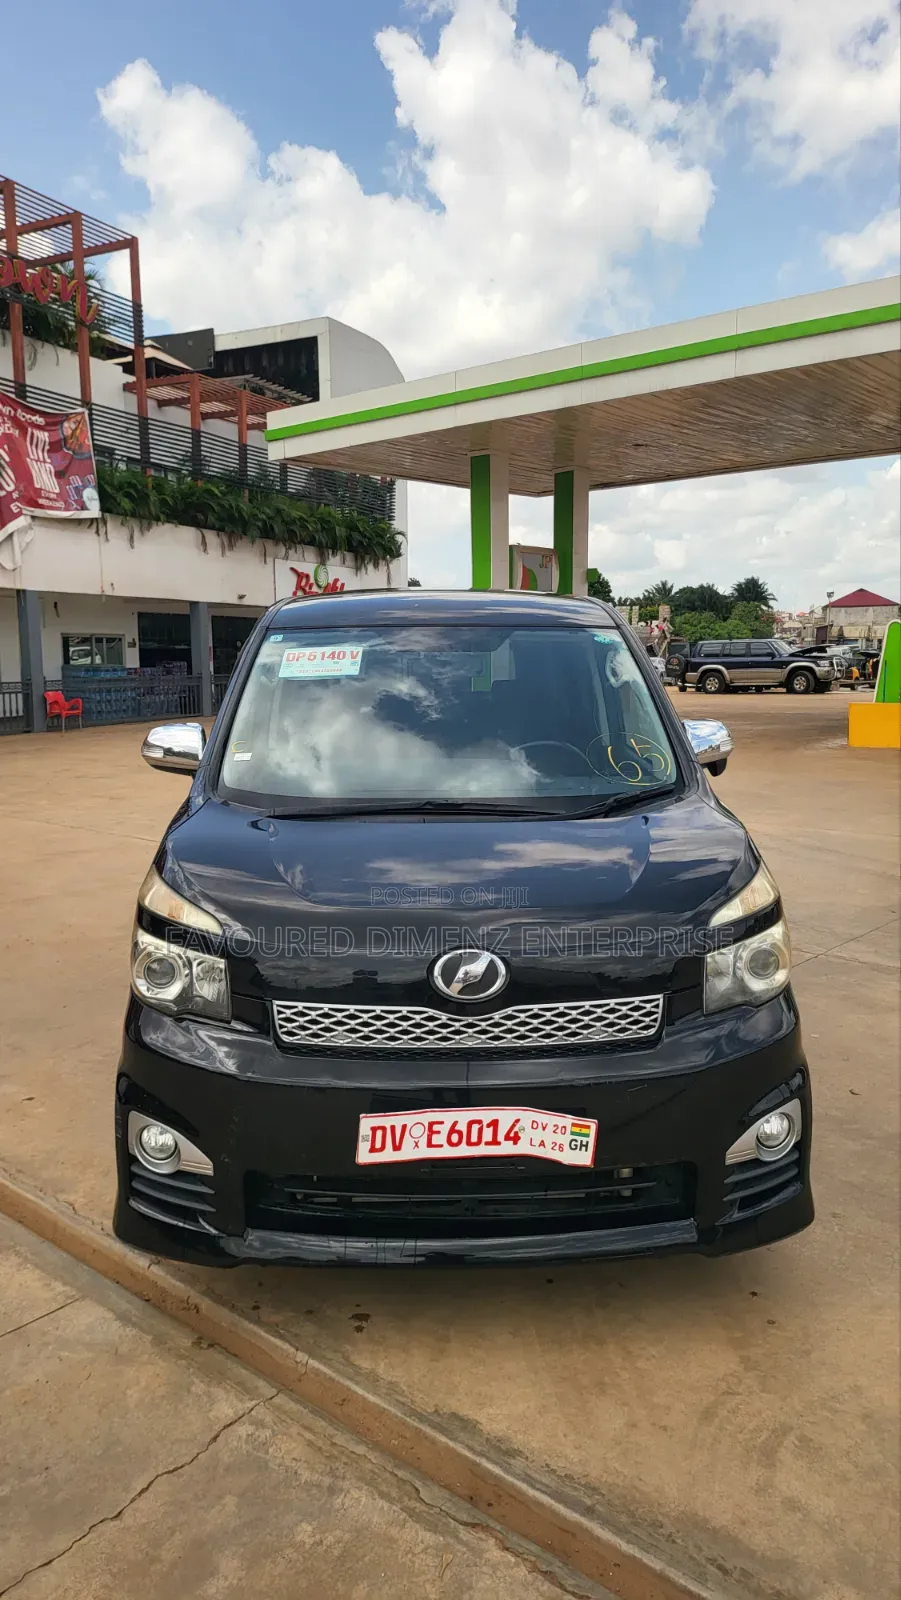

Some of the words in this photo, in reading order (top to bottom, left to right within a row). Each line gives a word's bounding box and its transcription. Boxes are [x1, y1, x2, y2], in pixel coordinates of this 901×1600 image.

[539, 554, 552, 569] JP
[350, 650, 360, 660] V
[531, 1119, 549, 1132] DV
[552, 1123, 567, 1136] 20
[368, 1123, 408, 1154] DV
[426, 1118, 522, 1149] E6014
[529, 1137, 547, 1149] LA
[550, 1141, 565, 1153] 26
[568, 1138, 590, 1153] GH
